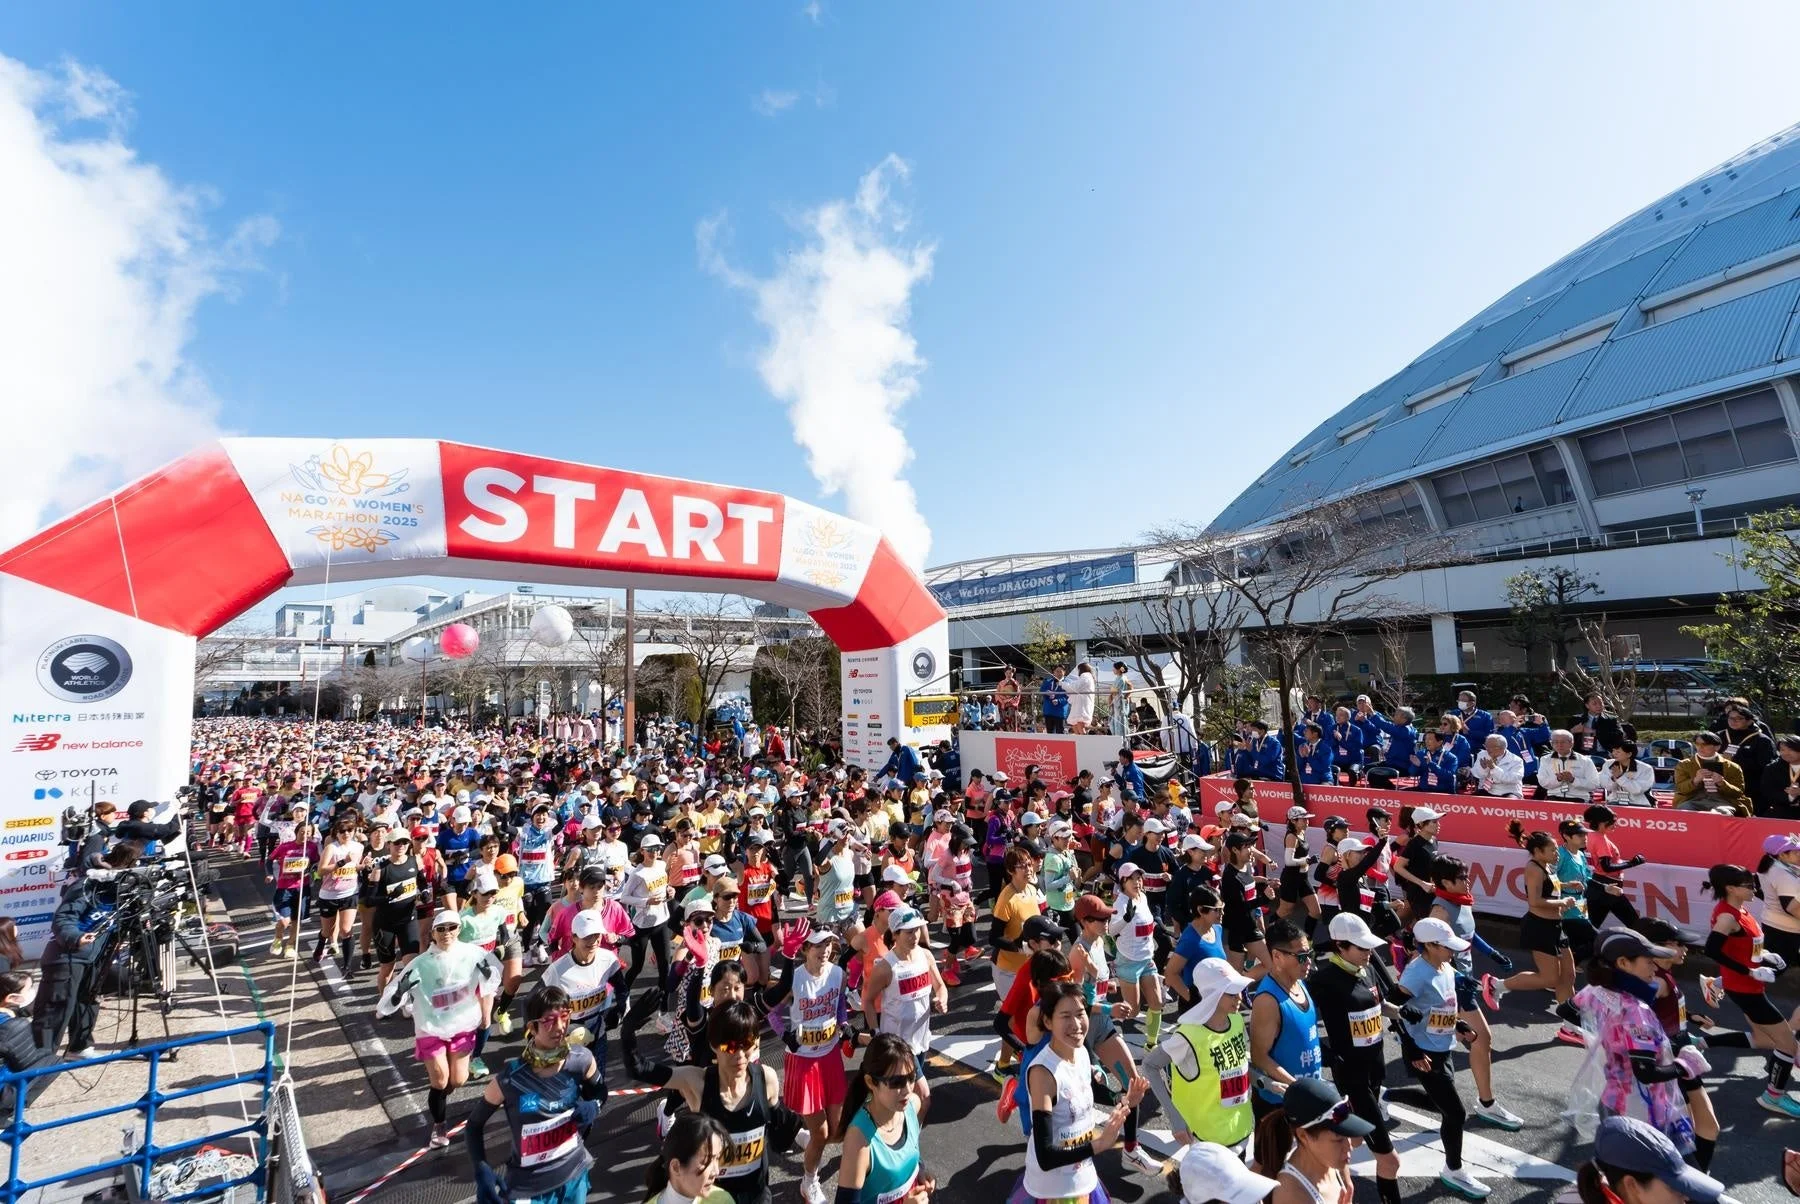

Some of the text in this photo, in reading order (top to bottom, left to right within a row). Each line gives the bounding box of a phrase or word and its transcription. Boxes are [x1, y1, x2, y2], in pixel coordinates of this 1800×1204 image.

[281, 492, 424, 514] NAGOYA WOMEN'S
[288, 508, 418, 527] MARATHON 2025
[459, 467, 774, 564] START
[1080, 562, 1121, 582] Dragons
[959, 588, 971, 598] We
[974, 586, 997, 596] Love
[998, 575, 1054, 592] DRAGONS
[13, 713, 71, 723] Niterra
[922, 715, 951, 726] SEIKO
[62, 741, 89, 750] new
[92, 739, 144, 750] balance
[61, 767, 118, 778] TOYOTA
[1220, 787, 1258, 798] NAGA
[1309, 794, 1370, 805] MARATHON
[1373, 798, 1401, 808] 2025
[6, 817, 53, 829] SEIKO
[1424, 802, 1688, 832] NAGOYA WOMEN'S MARON 2025
[1, 832, 55, 846] AQUARIUS
[21, 864, 47, 877] TCB
